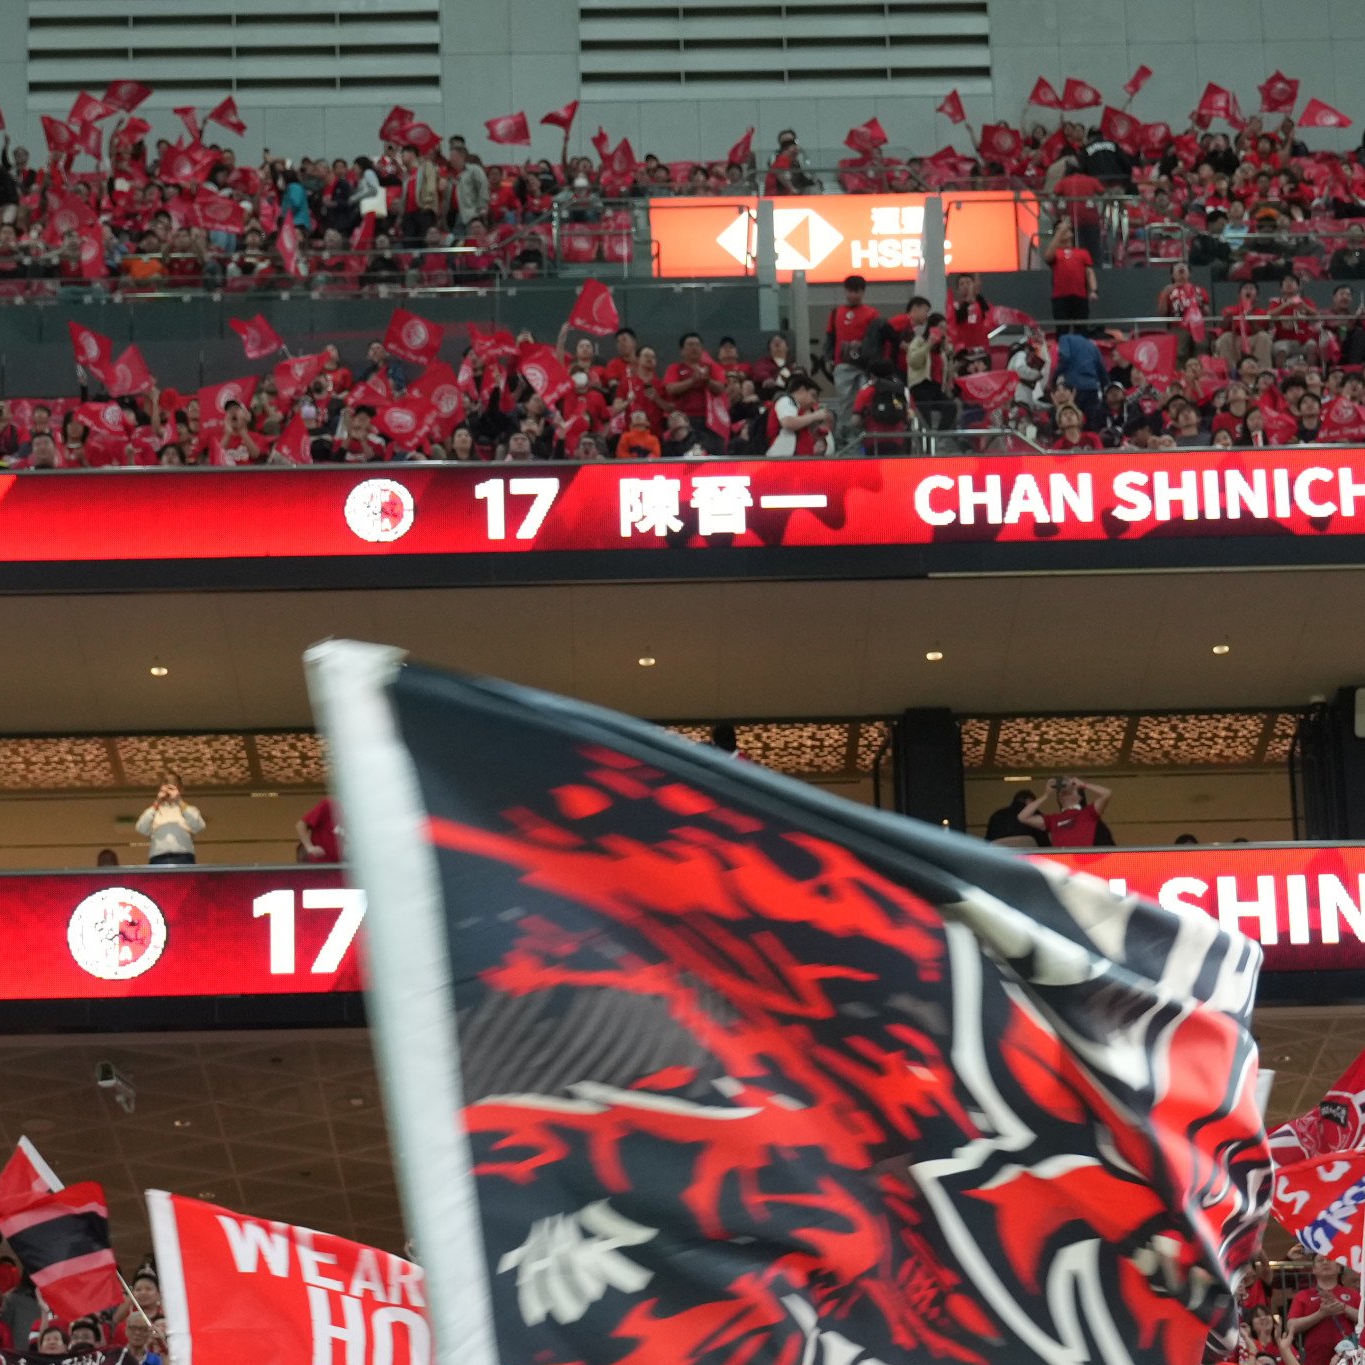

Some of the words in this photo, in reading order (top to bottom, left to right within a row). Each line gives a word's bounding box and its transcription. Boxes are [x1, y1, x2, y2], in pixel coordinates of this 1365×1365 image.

[851, 240, 952, 269] HSB
[474, 477, 559, 540] 17
[619, 475, 828, 537] 陳晉一
[914, 473, 1094, 526] CHAN
[252, 889, 368, 975] 17
